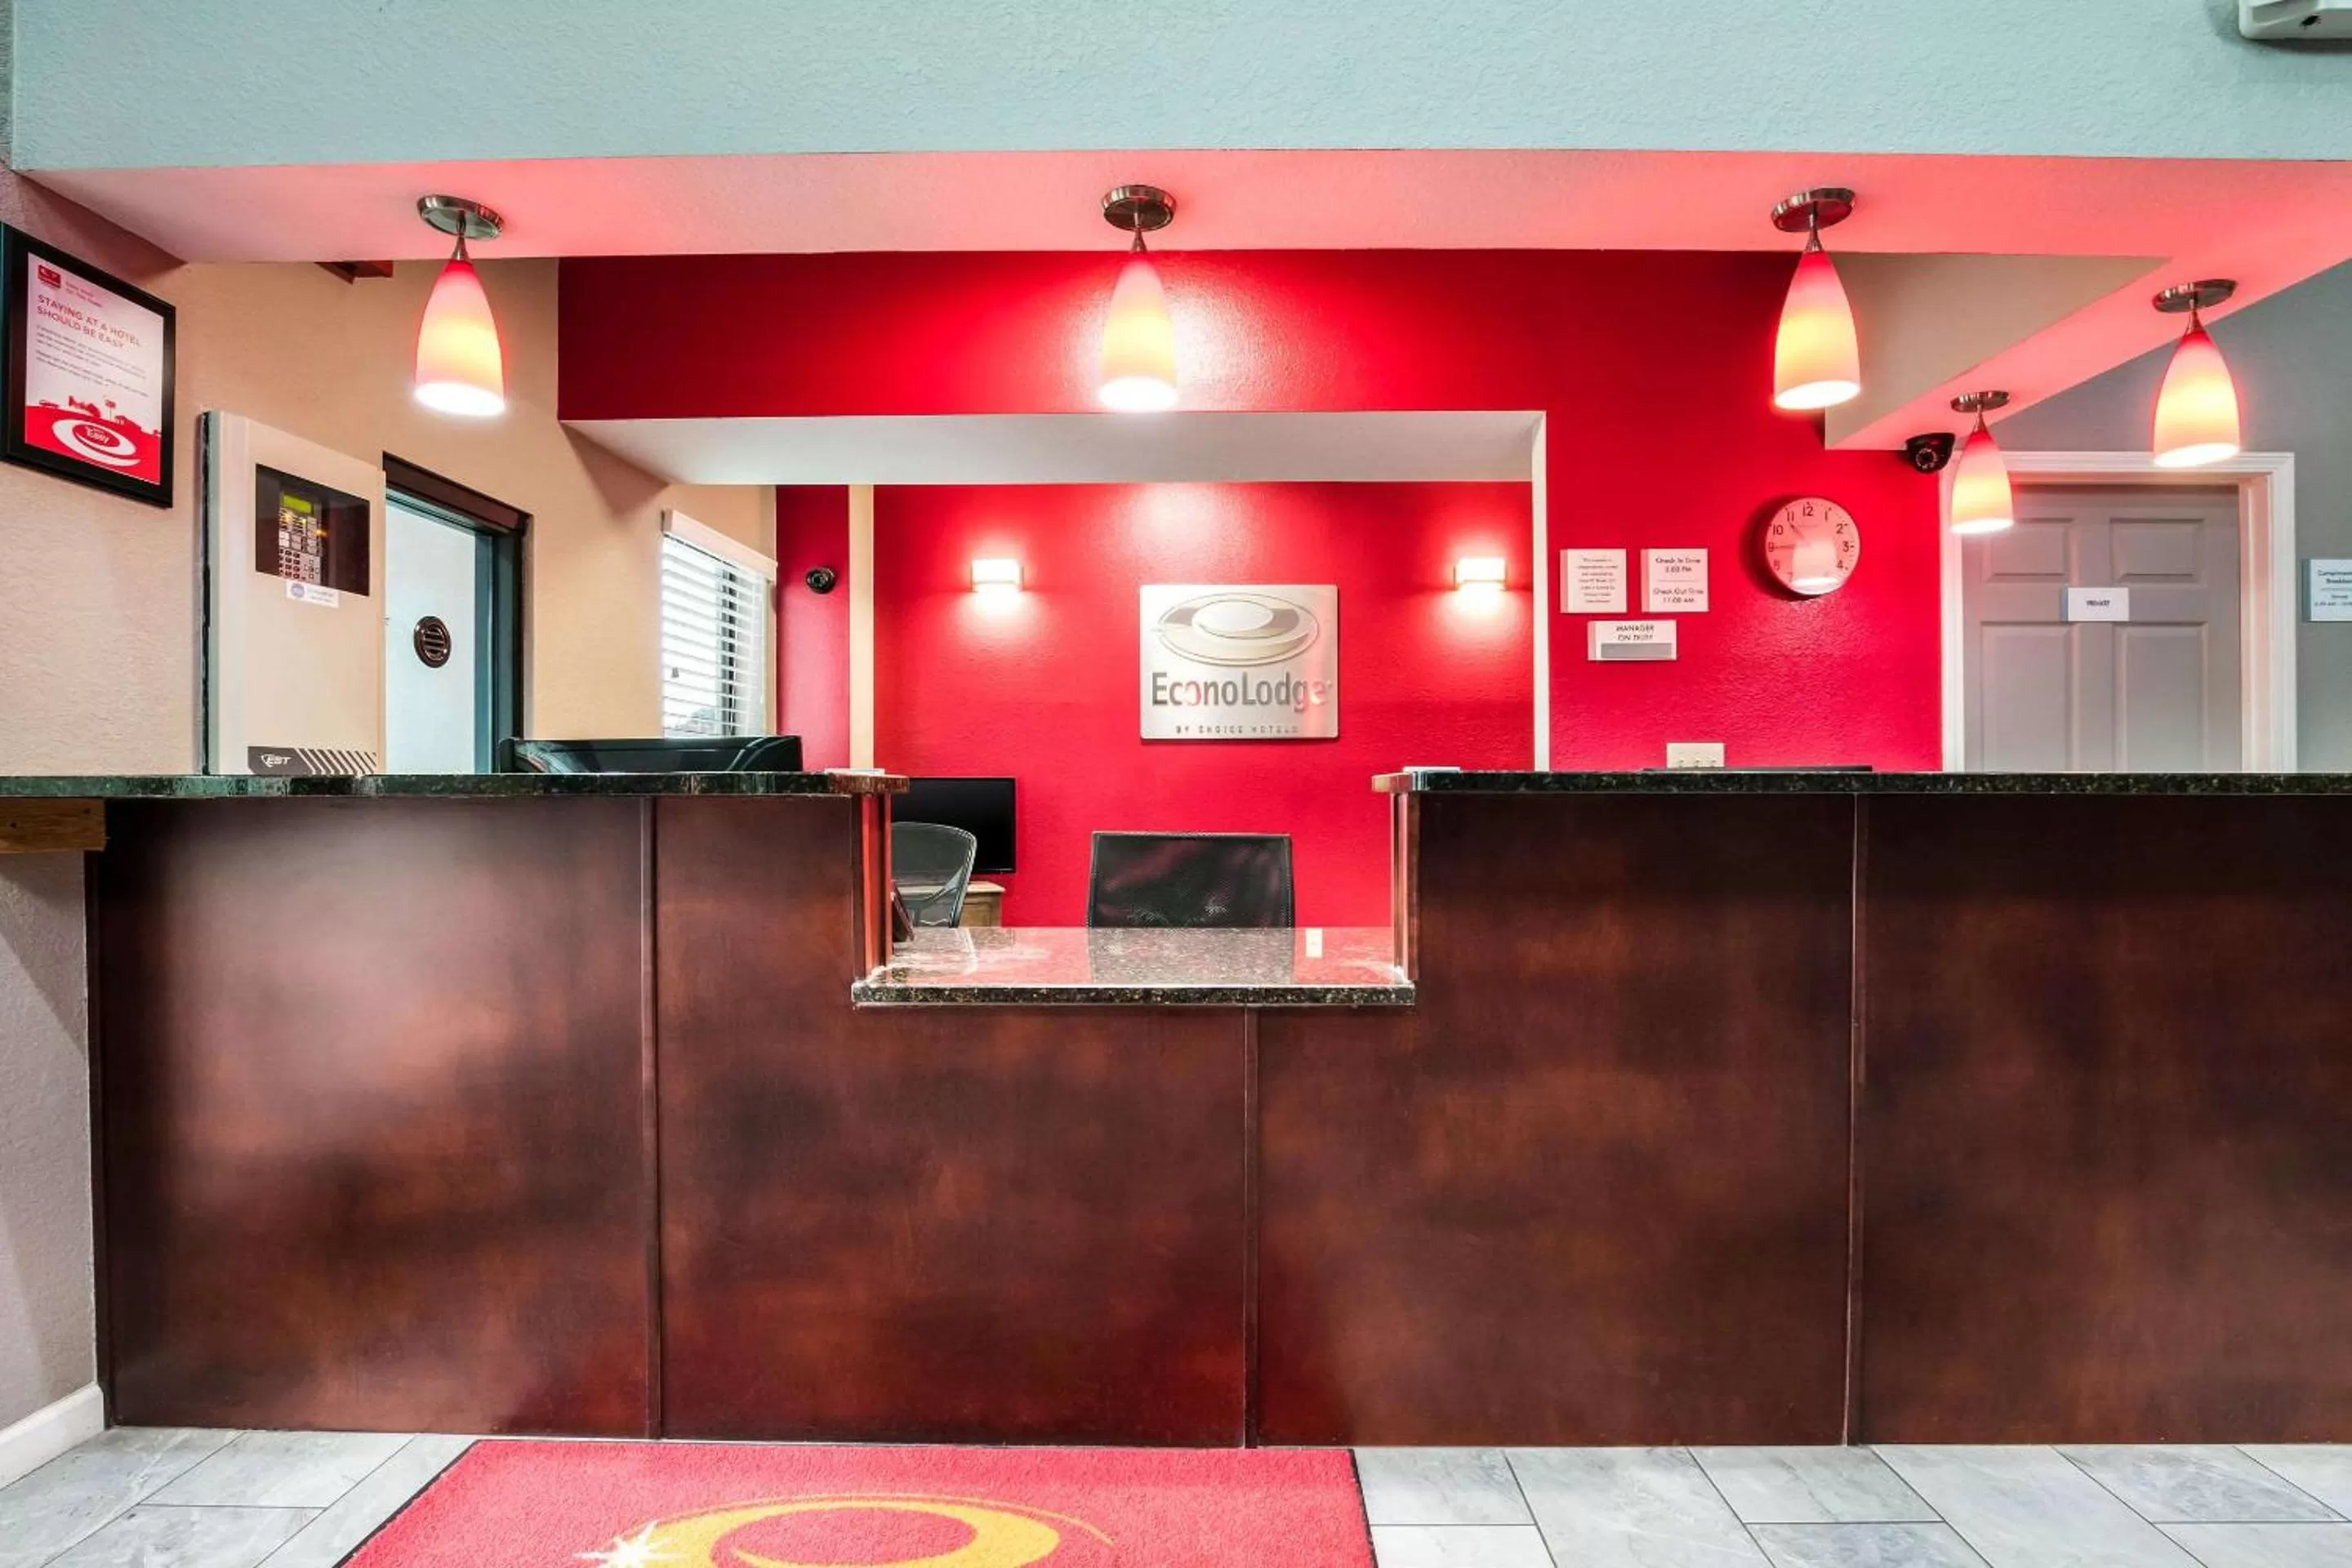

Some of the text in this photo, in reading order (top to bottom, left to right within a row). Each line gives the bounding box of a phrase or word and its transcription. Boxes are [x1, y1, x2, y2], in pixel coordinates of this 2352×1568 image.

[38, 294, 82, 321] STAYING
[86, 316, 98, 326] AT
[110, 326, 140, 347] HOTEL
[38, 305, 81, 330] SHOULD
[82, 326, 96, 337] BE
[1787, 510, 1795, 523] 11
[1802, 506, 1814, 517] 12
[1824, 510, 1829, 521] 1
[1772, 523, 1784, 536] 10
[1836, 523, 1844, 534] 2
[1842, 541, 1850, 553] 3
[1152, 671, 1327, 713] EconoLodge
[1176, 725, 1190, 734] BY
[1198, 725, 1244, 734] CHOICE
